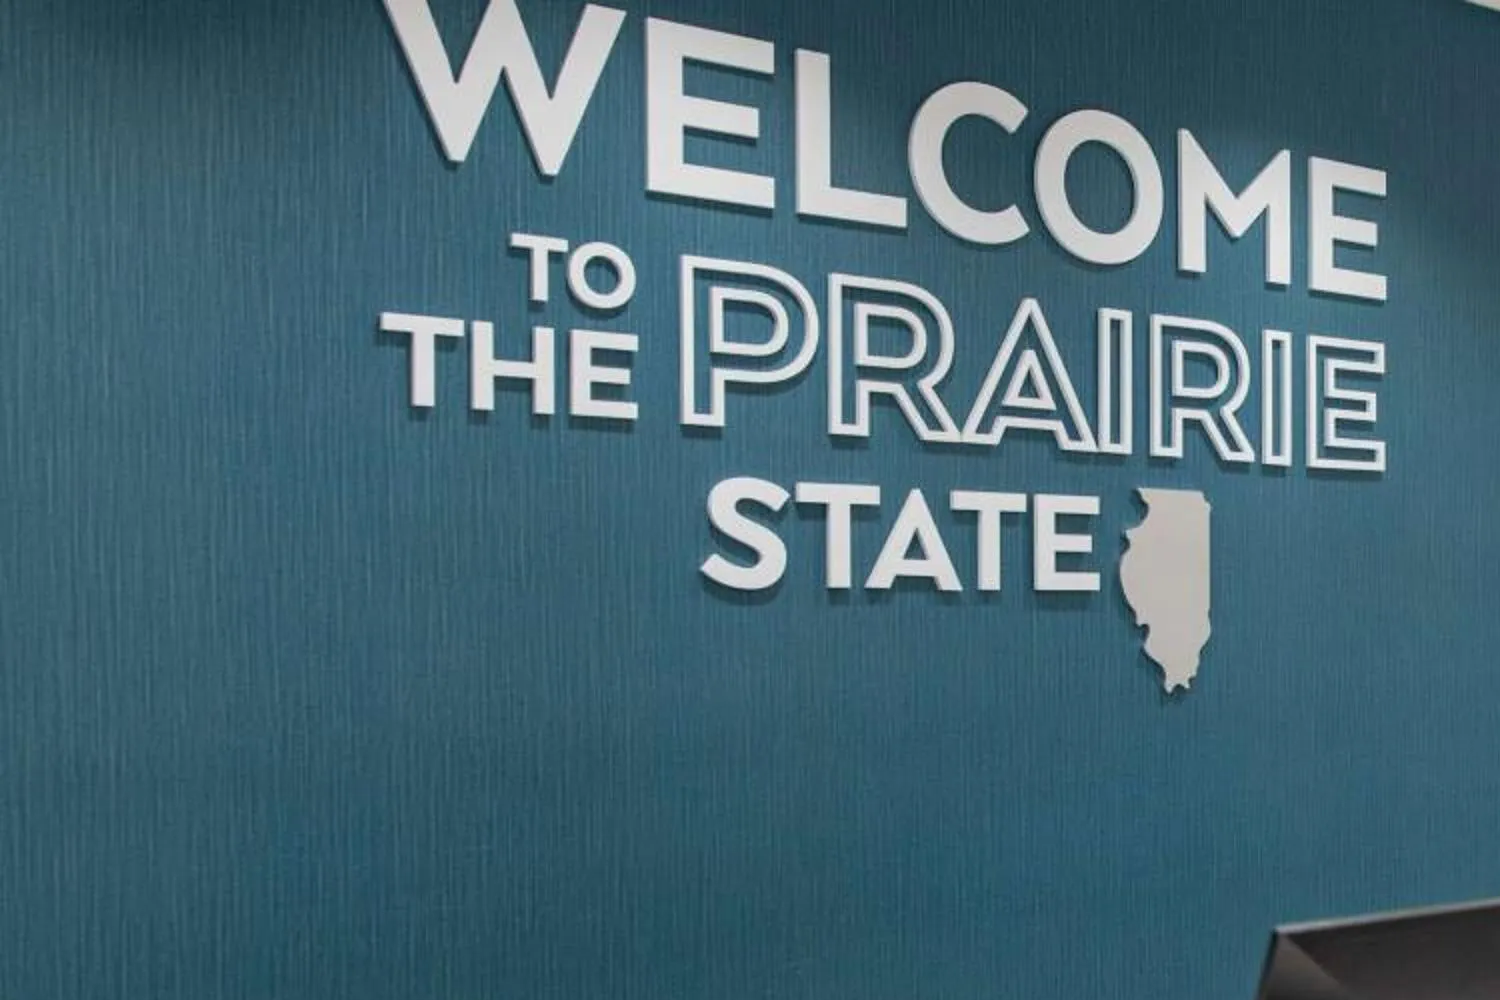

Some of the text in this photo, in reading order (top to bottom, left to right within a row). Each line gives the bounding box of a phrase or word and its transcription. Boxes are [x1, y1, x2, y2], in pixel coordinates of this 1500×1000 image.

[383, 0, 1388, 302] WELCOME
[511, 232, 637, 310] TO
[380, 254, 1387, 472] THE PRAIRIE
[700, 477, 1101, 592] STATE
